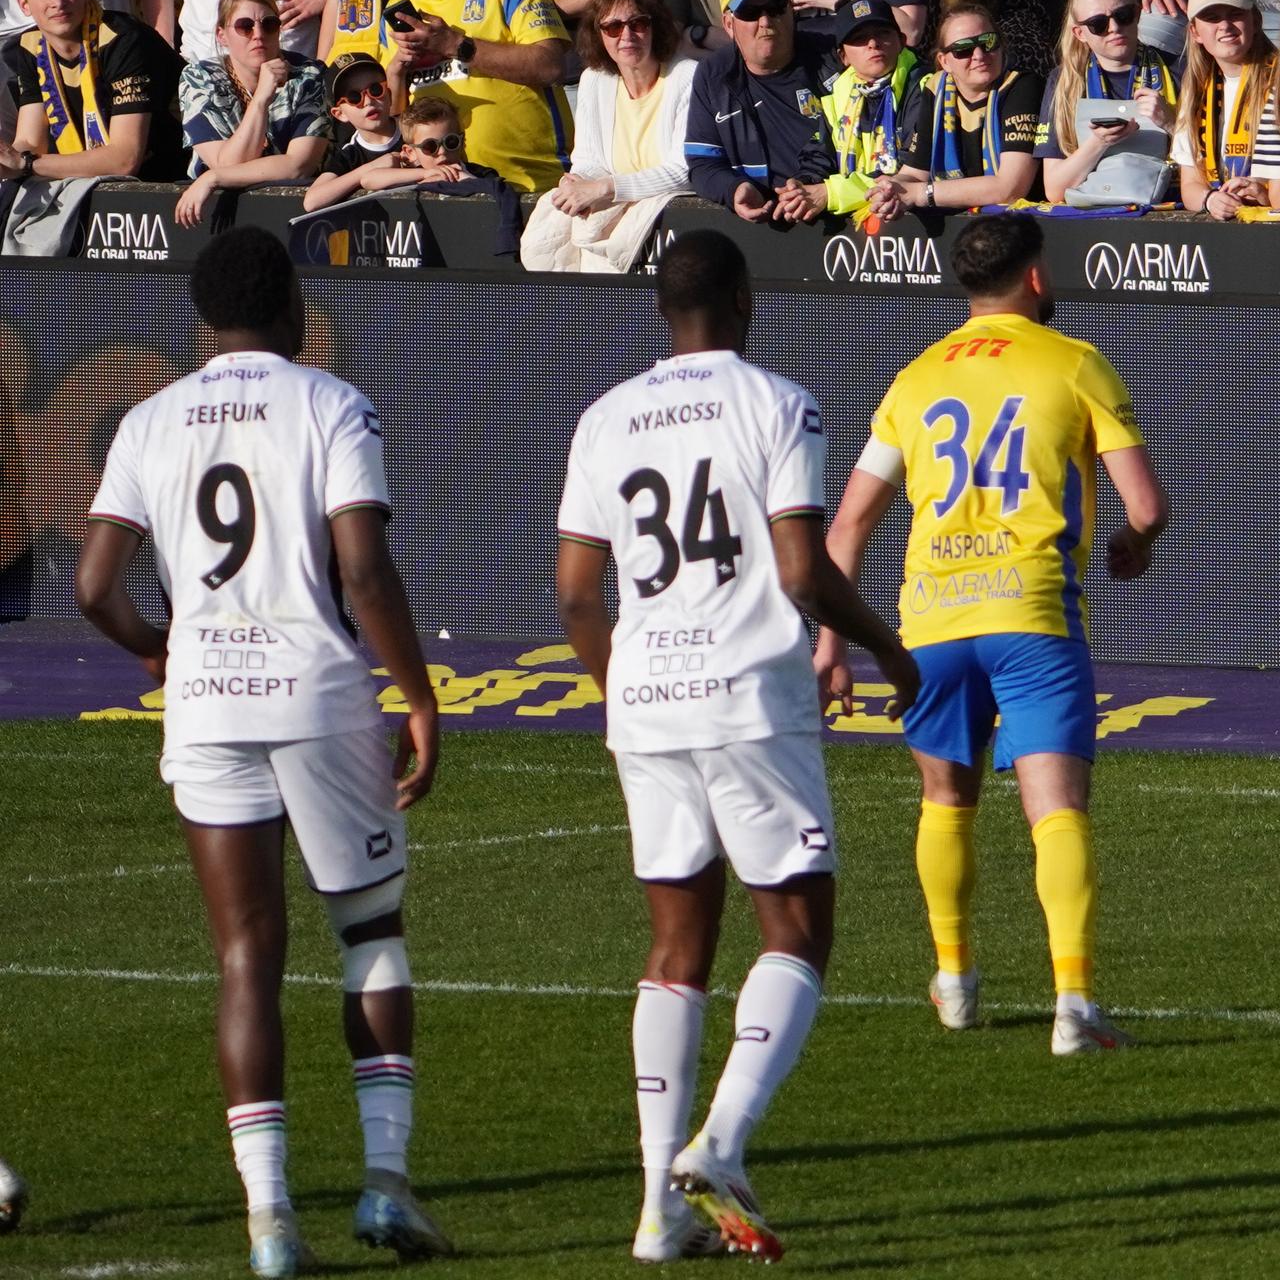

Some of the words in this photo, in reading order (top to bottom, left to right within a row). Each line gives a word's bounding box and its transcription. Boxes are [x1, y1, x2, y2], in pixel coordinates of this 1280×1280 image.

[86, 211, 169, 249] ARMA
[859, 235, 943, 274] ARMA
[1123, 242, 1210, 281] ARMA
[943, 337, 1012, 363] 777
[200, 368, 270, 385] banqup
[646, 366, 713, 387] banqup
[185, 401, 269, 427] ZEEFUIK
[627, 401, 724, 436] NYAKOSSI
[921, 394, 1031, 519] 34
[195, 462, 257, 592] 9
[617, 456, 743, 600] 34
[930, 530, 1013, 561] HASPOLAT
[940, 566, 1024, 599] ARMA
[985, 589, 1024, 600] TRADE
[197, 626, 278, 644] TEGEL
[645, 628, 717, 650] TEGEL
[181, 676, 299, 700] CONCEPT
[622, 676, 740, 707] CONCEPT
